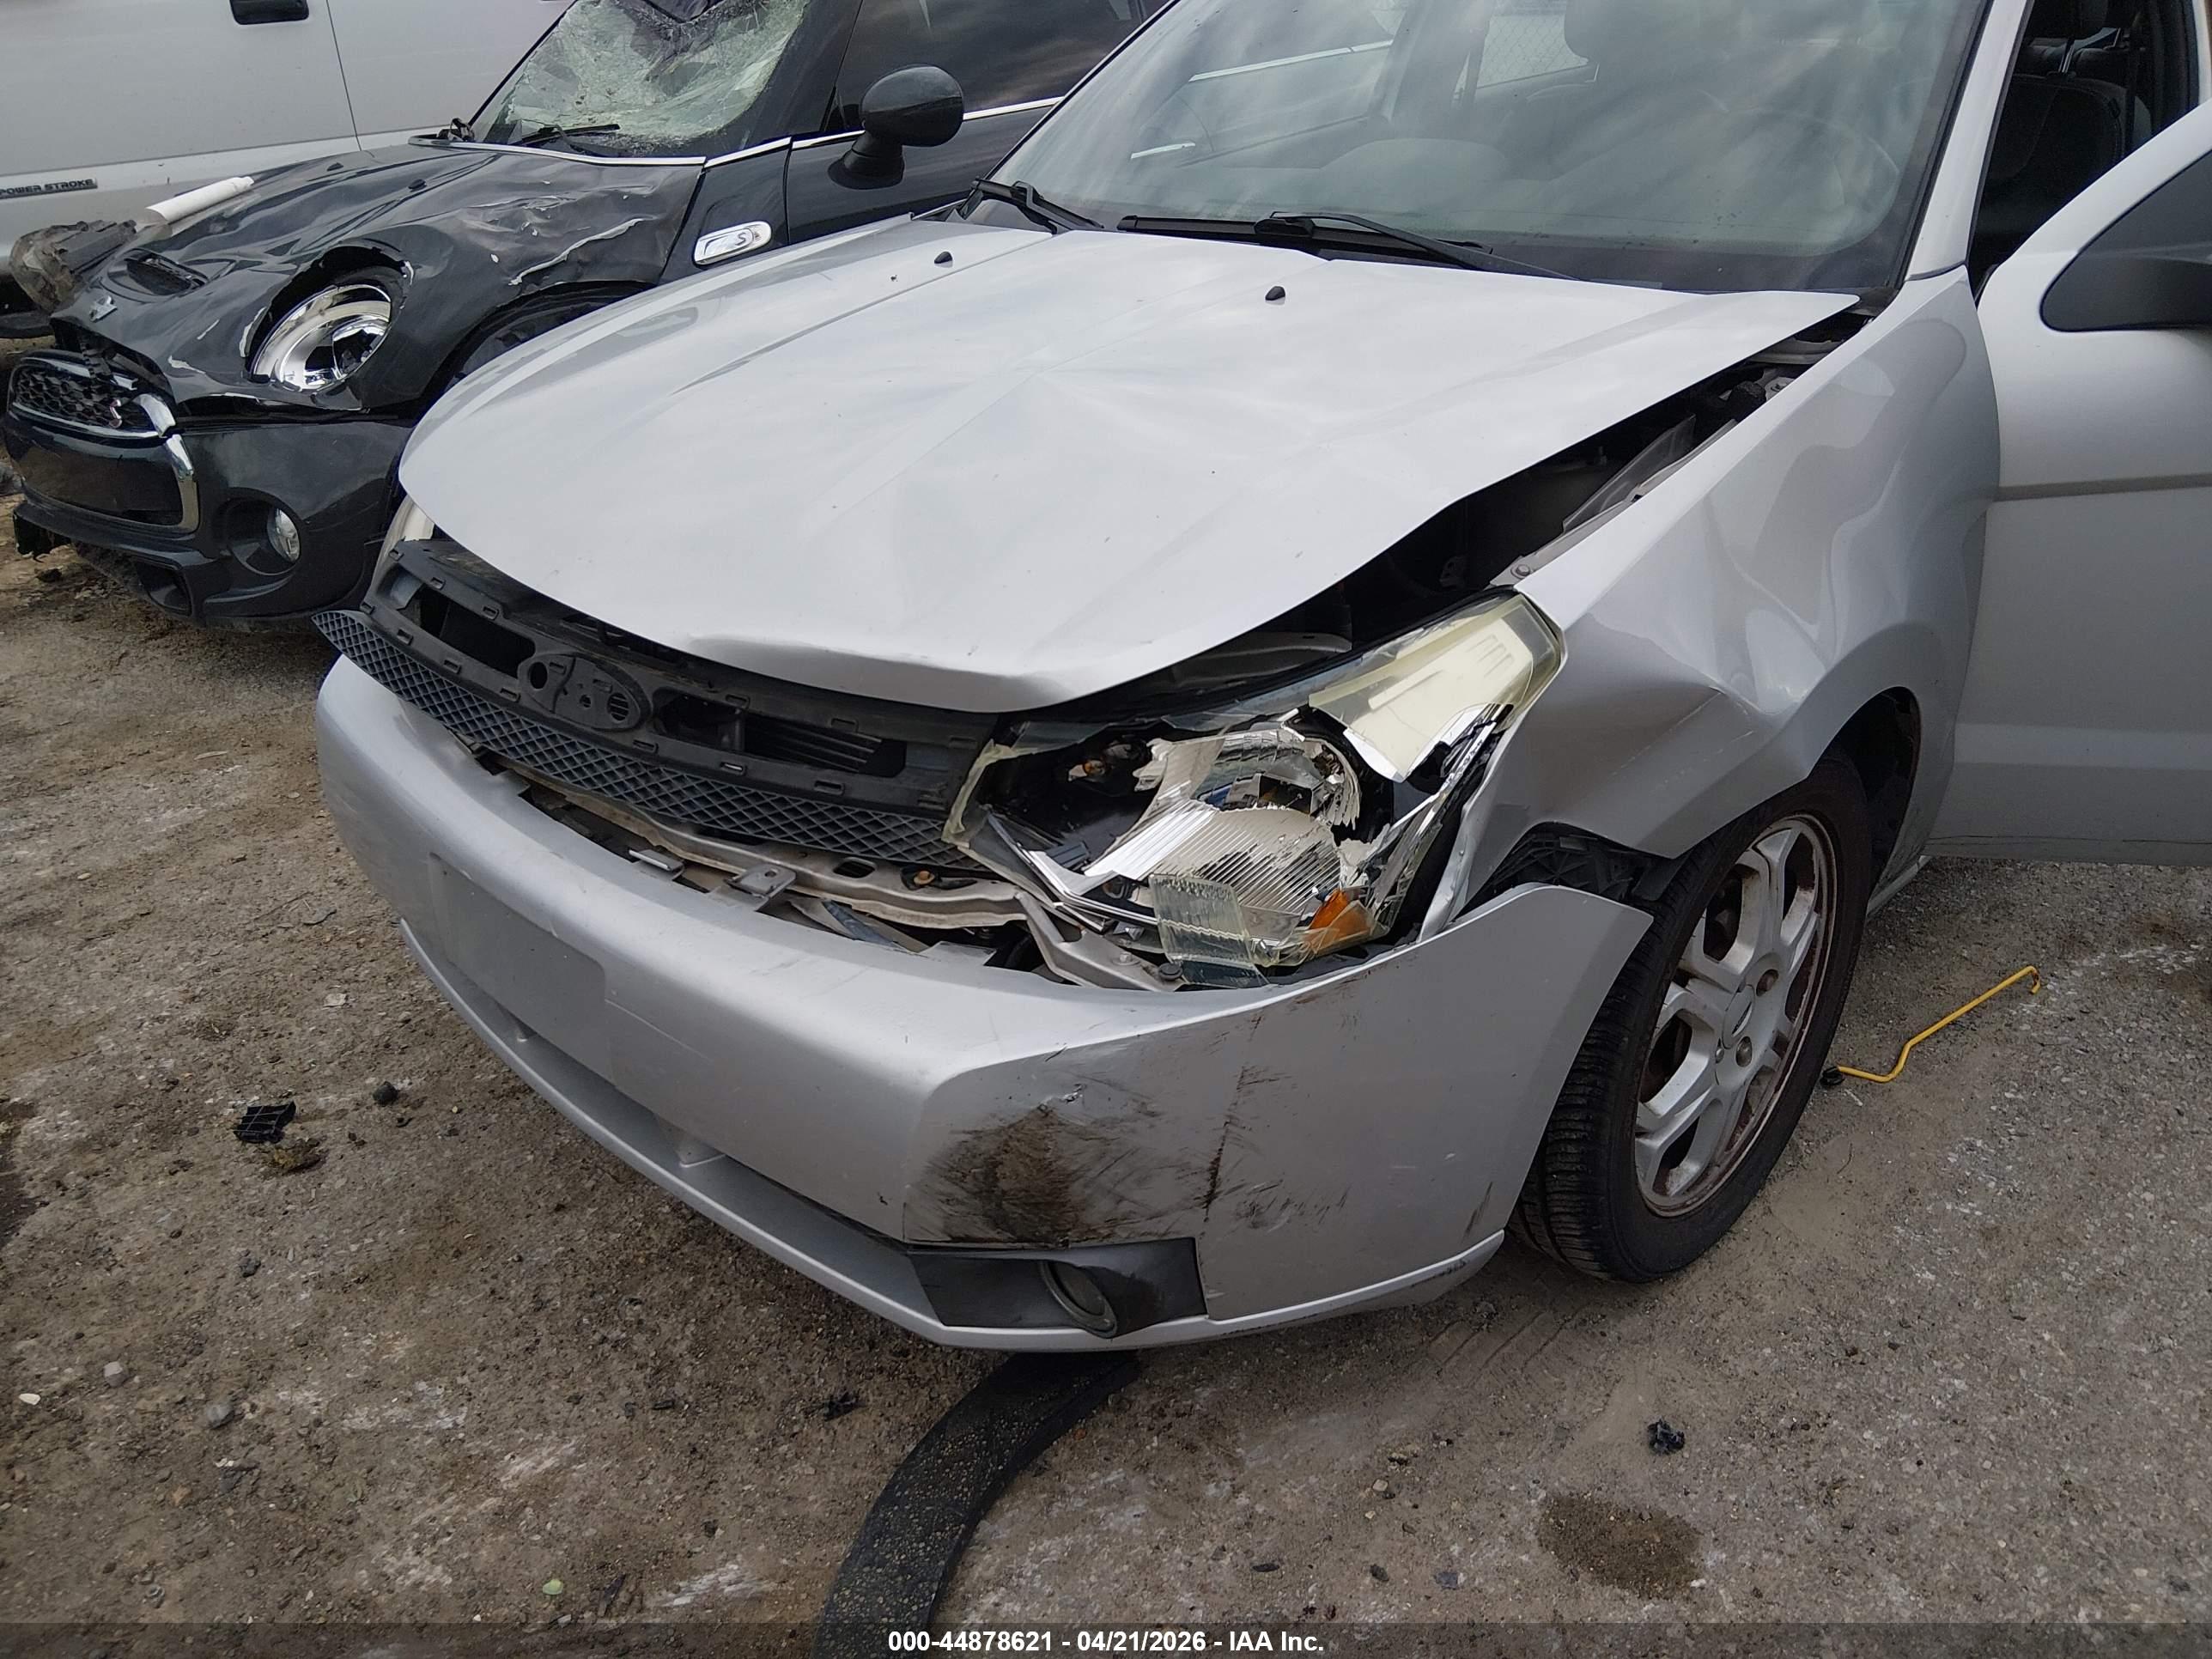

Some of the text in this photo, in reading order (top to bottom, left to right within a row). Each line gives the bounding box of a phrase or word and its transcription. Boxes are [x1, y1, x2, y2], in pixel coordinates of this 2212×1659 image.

[0, 179, 93, 195] POWER STROKE
[734, 231, 747, 246] S
